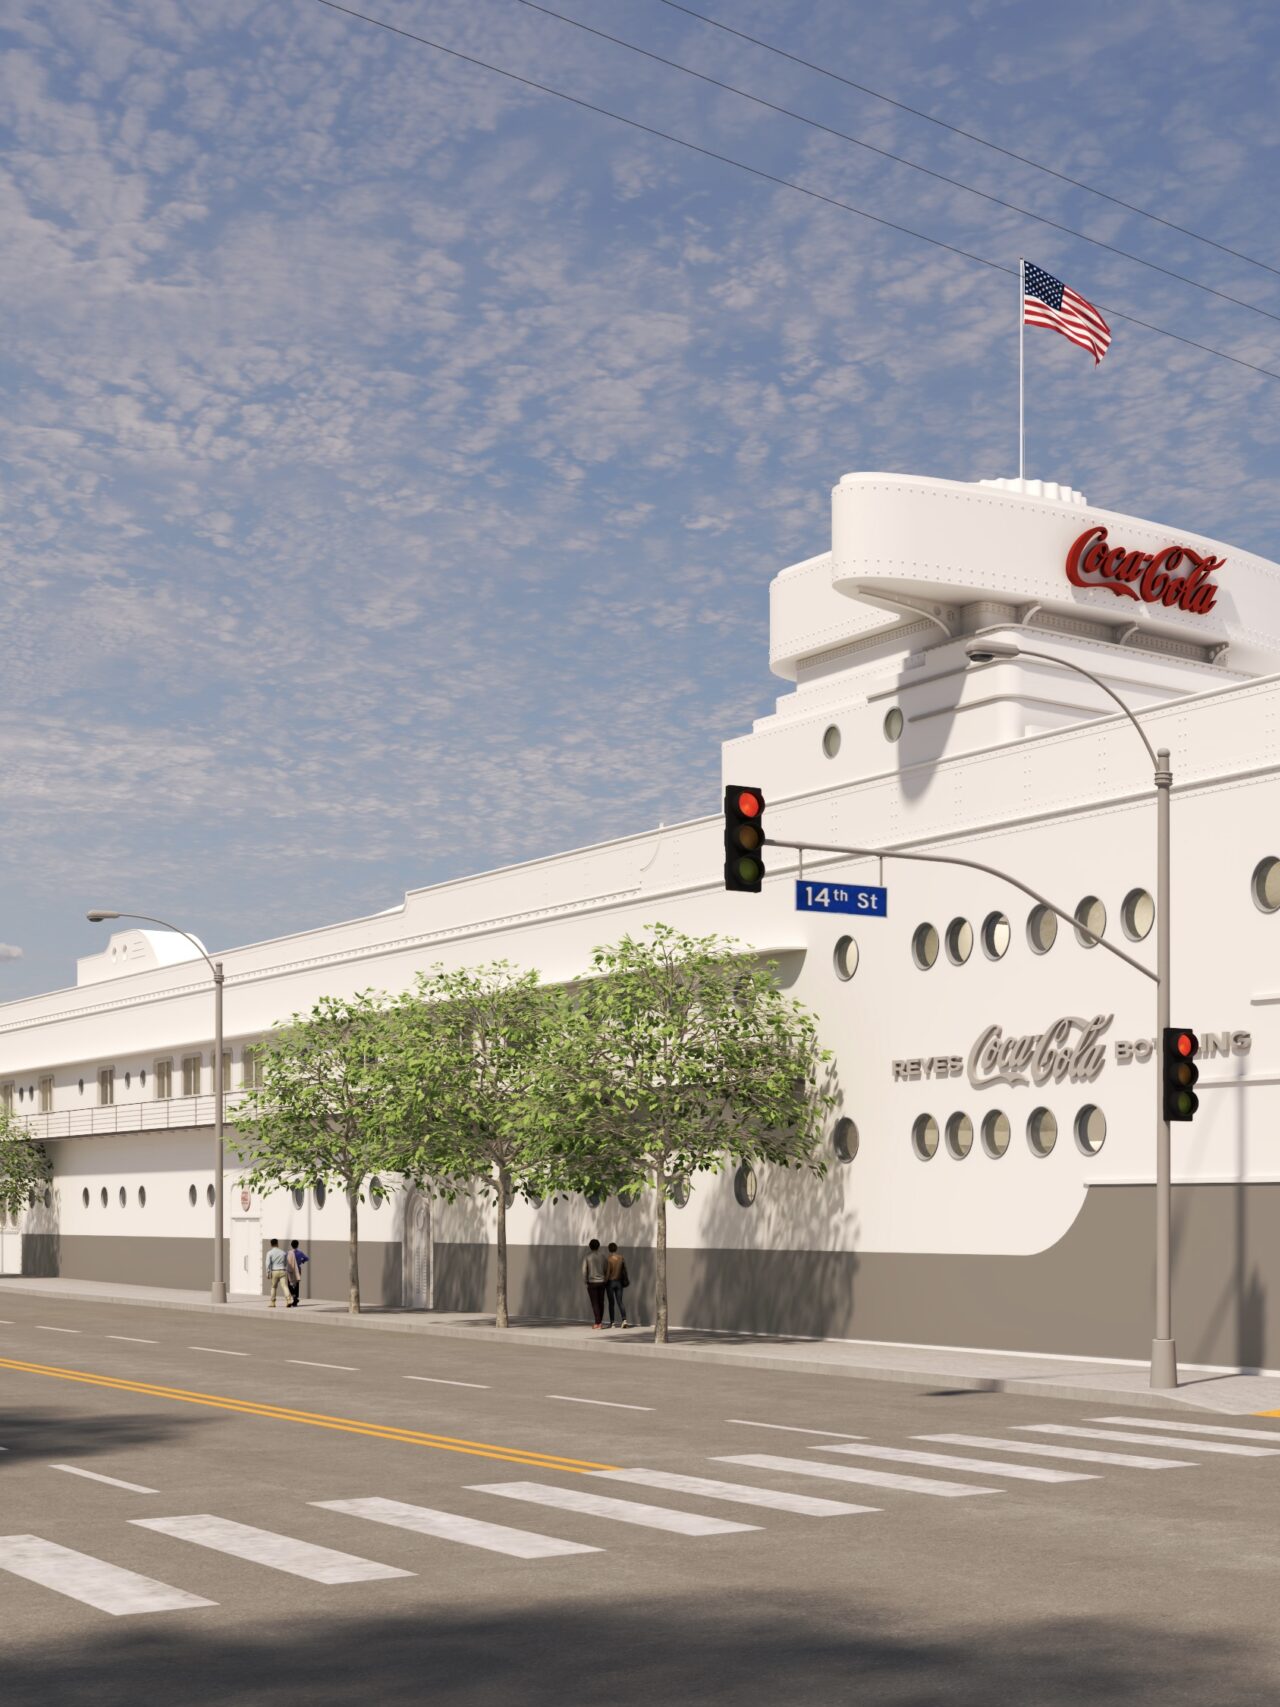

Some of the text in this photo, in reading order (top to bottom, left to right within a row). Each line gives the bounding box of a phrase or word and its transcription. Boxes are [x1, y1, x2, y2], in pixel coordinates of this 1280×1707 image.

[1066, 526, 1227, 615] Coca-Cola
[805, 886, 878, 910] 14th St
[892, 1013, 1251, 1089] REYES Coca-Cola BOING
